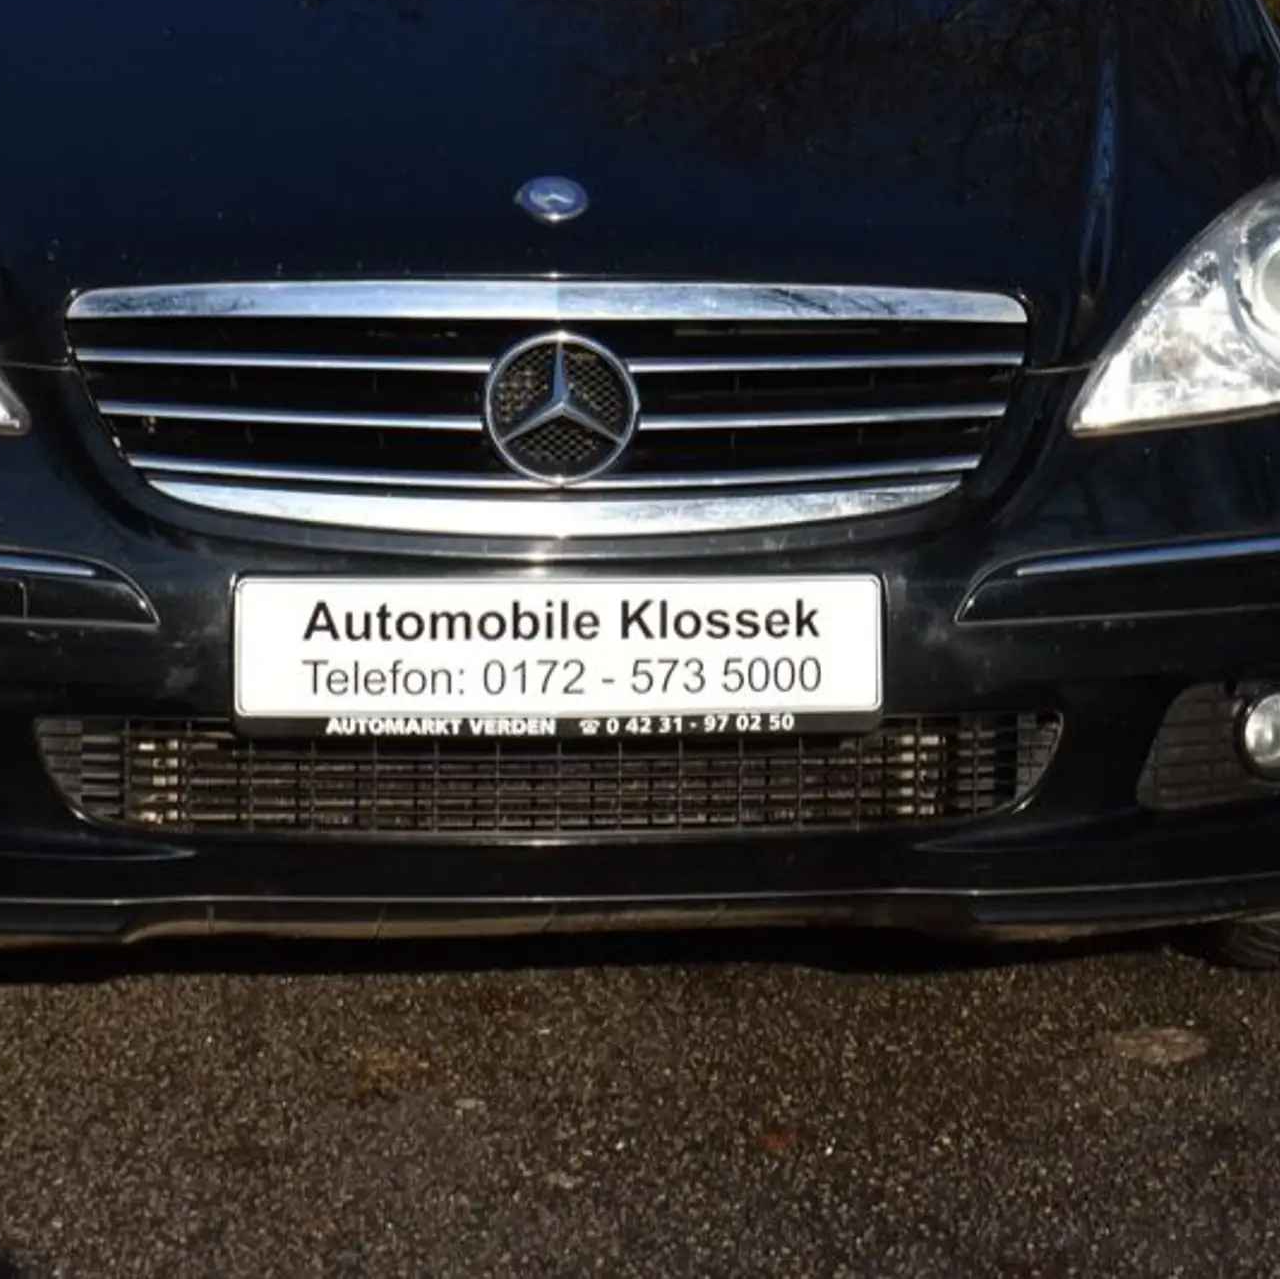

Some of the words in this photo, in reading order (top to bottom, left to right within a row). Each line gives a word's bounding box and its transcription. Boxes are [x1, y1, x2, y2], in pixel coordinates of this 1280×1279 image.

[302, 599, 601, 642] Automobile
[620, 597, 821, 640] Klossek
[301, 658, 465, 696] Telefon:
[482, 658, 586, 696] 0172
[630, 656, 706, 695] 573
[721, 656, 822, 693] 5000
[325, 717, 463, 736] AUTOMARKT
[469, 717, 556, 736] VERDEN
[605, 716, 619, 735] 0
[624, 716, 652, 735] 42
[658, 716, 684, 734] 31
[703, 715, 730, 734] 97
[735, 713, 762, 733] 02
[768, 712, 795, 732] 50
